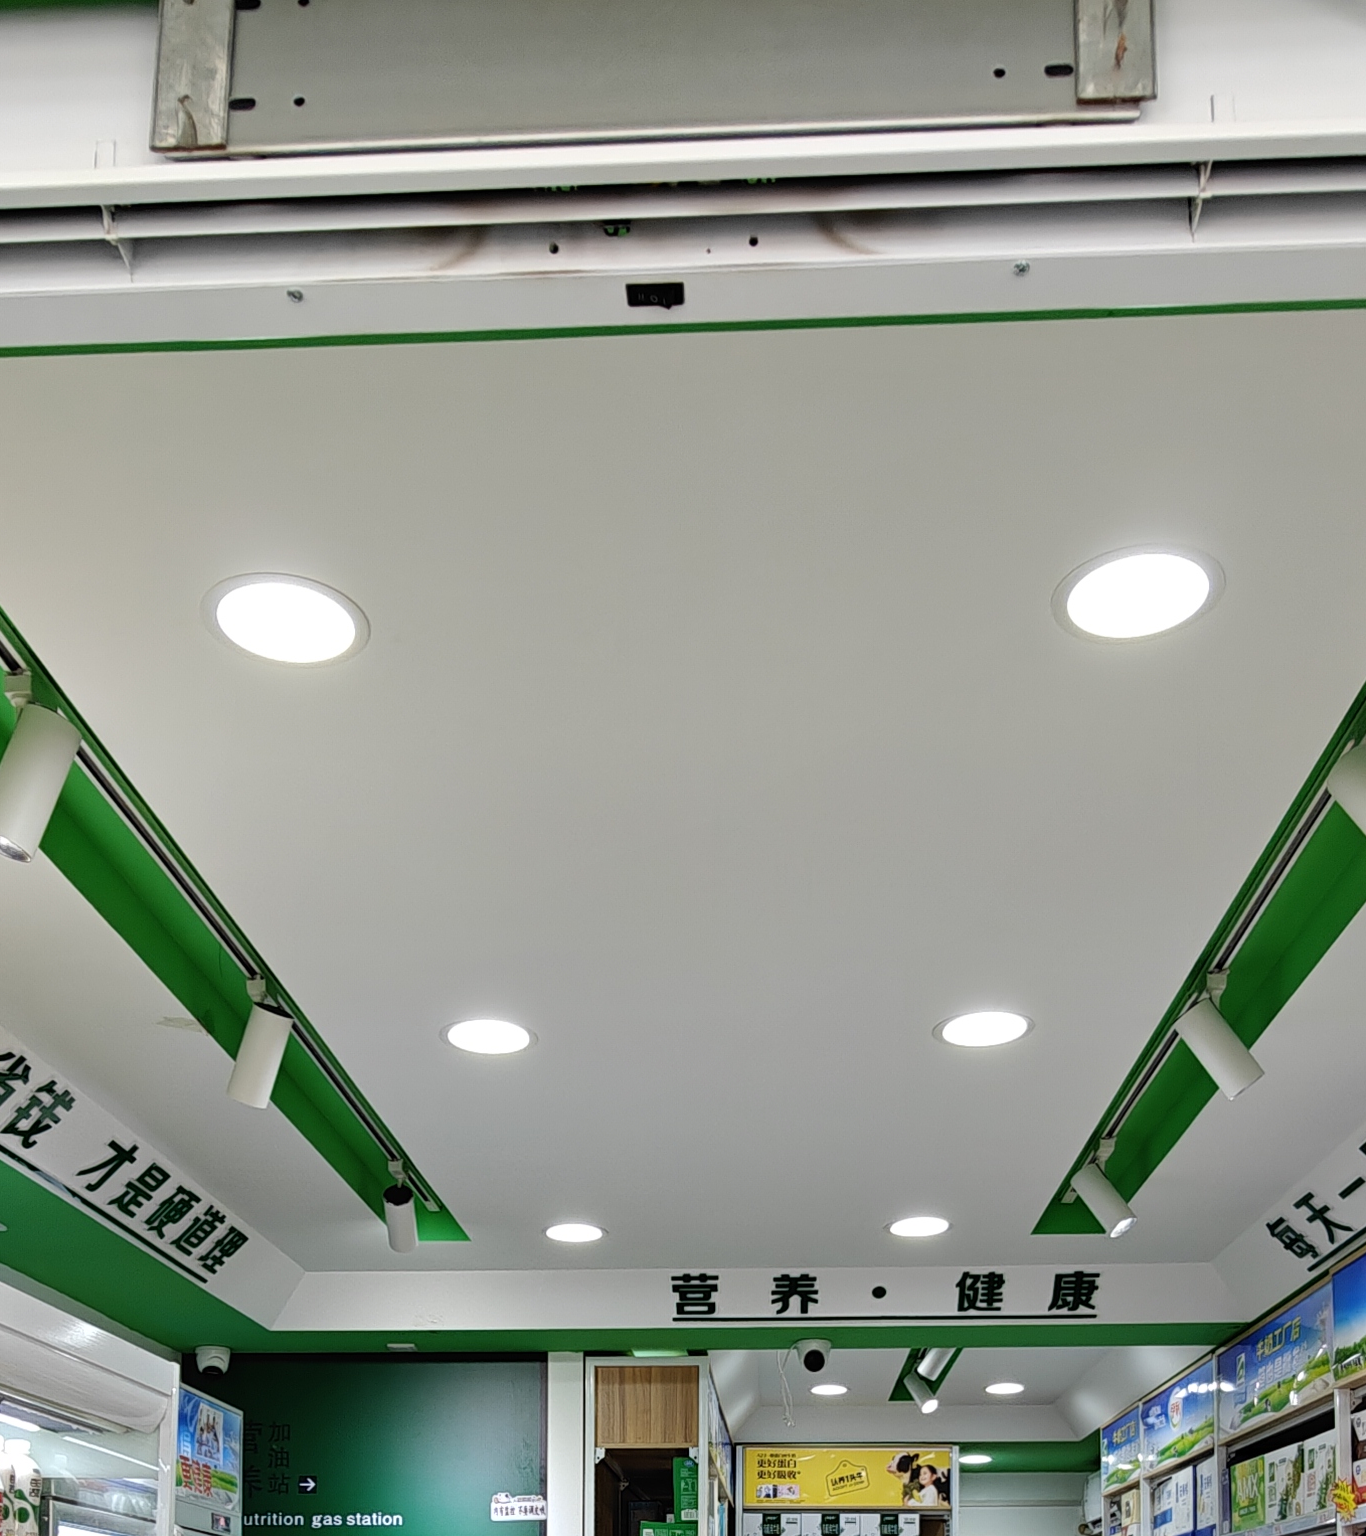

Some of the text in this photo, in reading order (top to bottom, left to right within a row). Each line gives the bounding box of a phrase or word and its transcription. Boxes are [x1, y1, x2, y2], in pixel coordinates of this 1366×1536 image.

[76, 1137, 249, 1276] 才是硬道理
[268, 1420, 291, 1496] 加油站
[757, 1458, 797, 1469] 更好蛋白
[312, 1512, 344, 1528] gas
[346, 1512, 403, 1527] station
